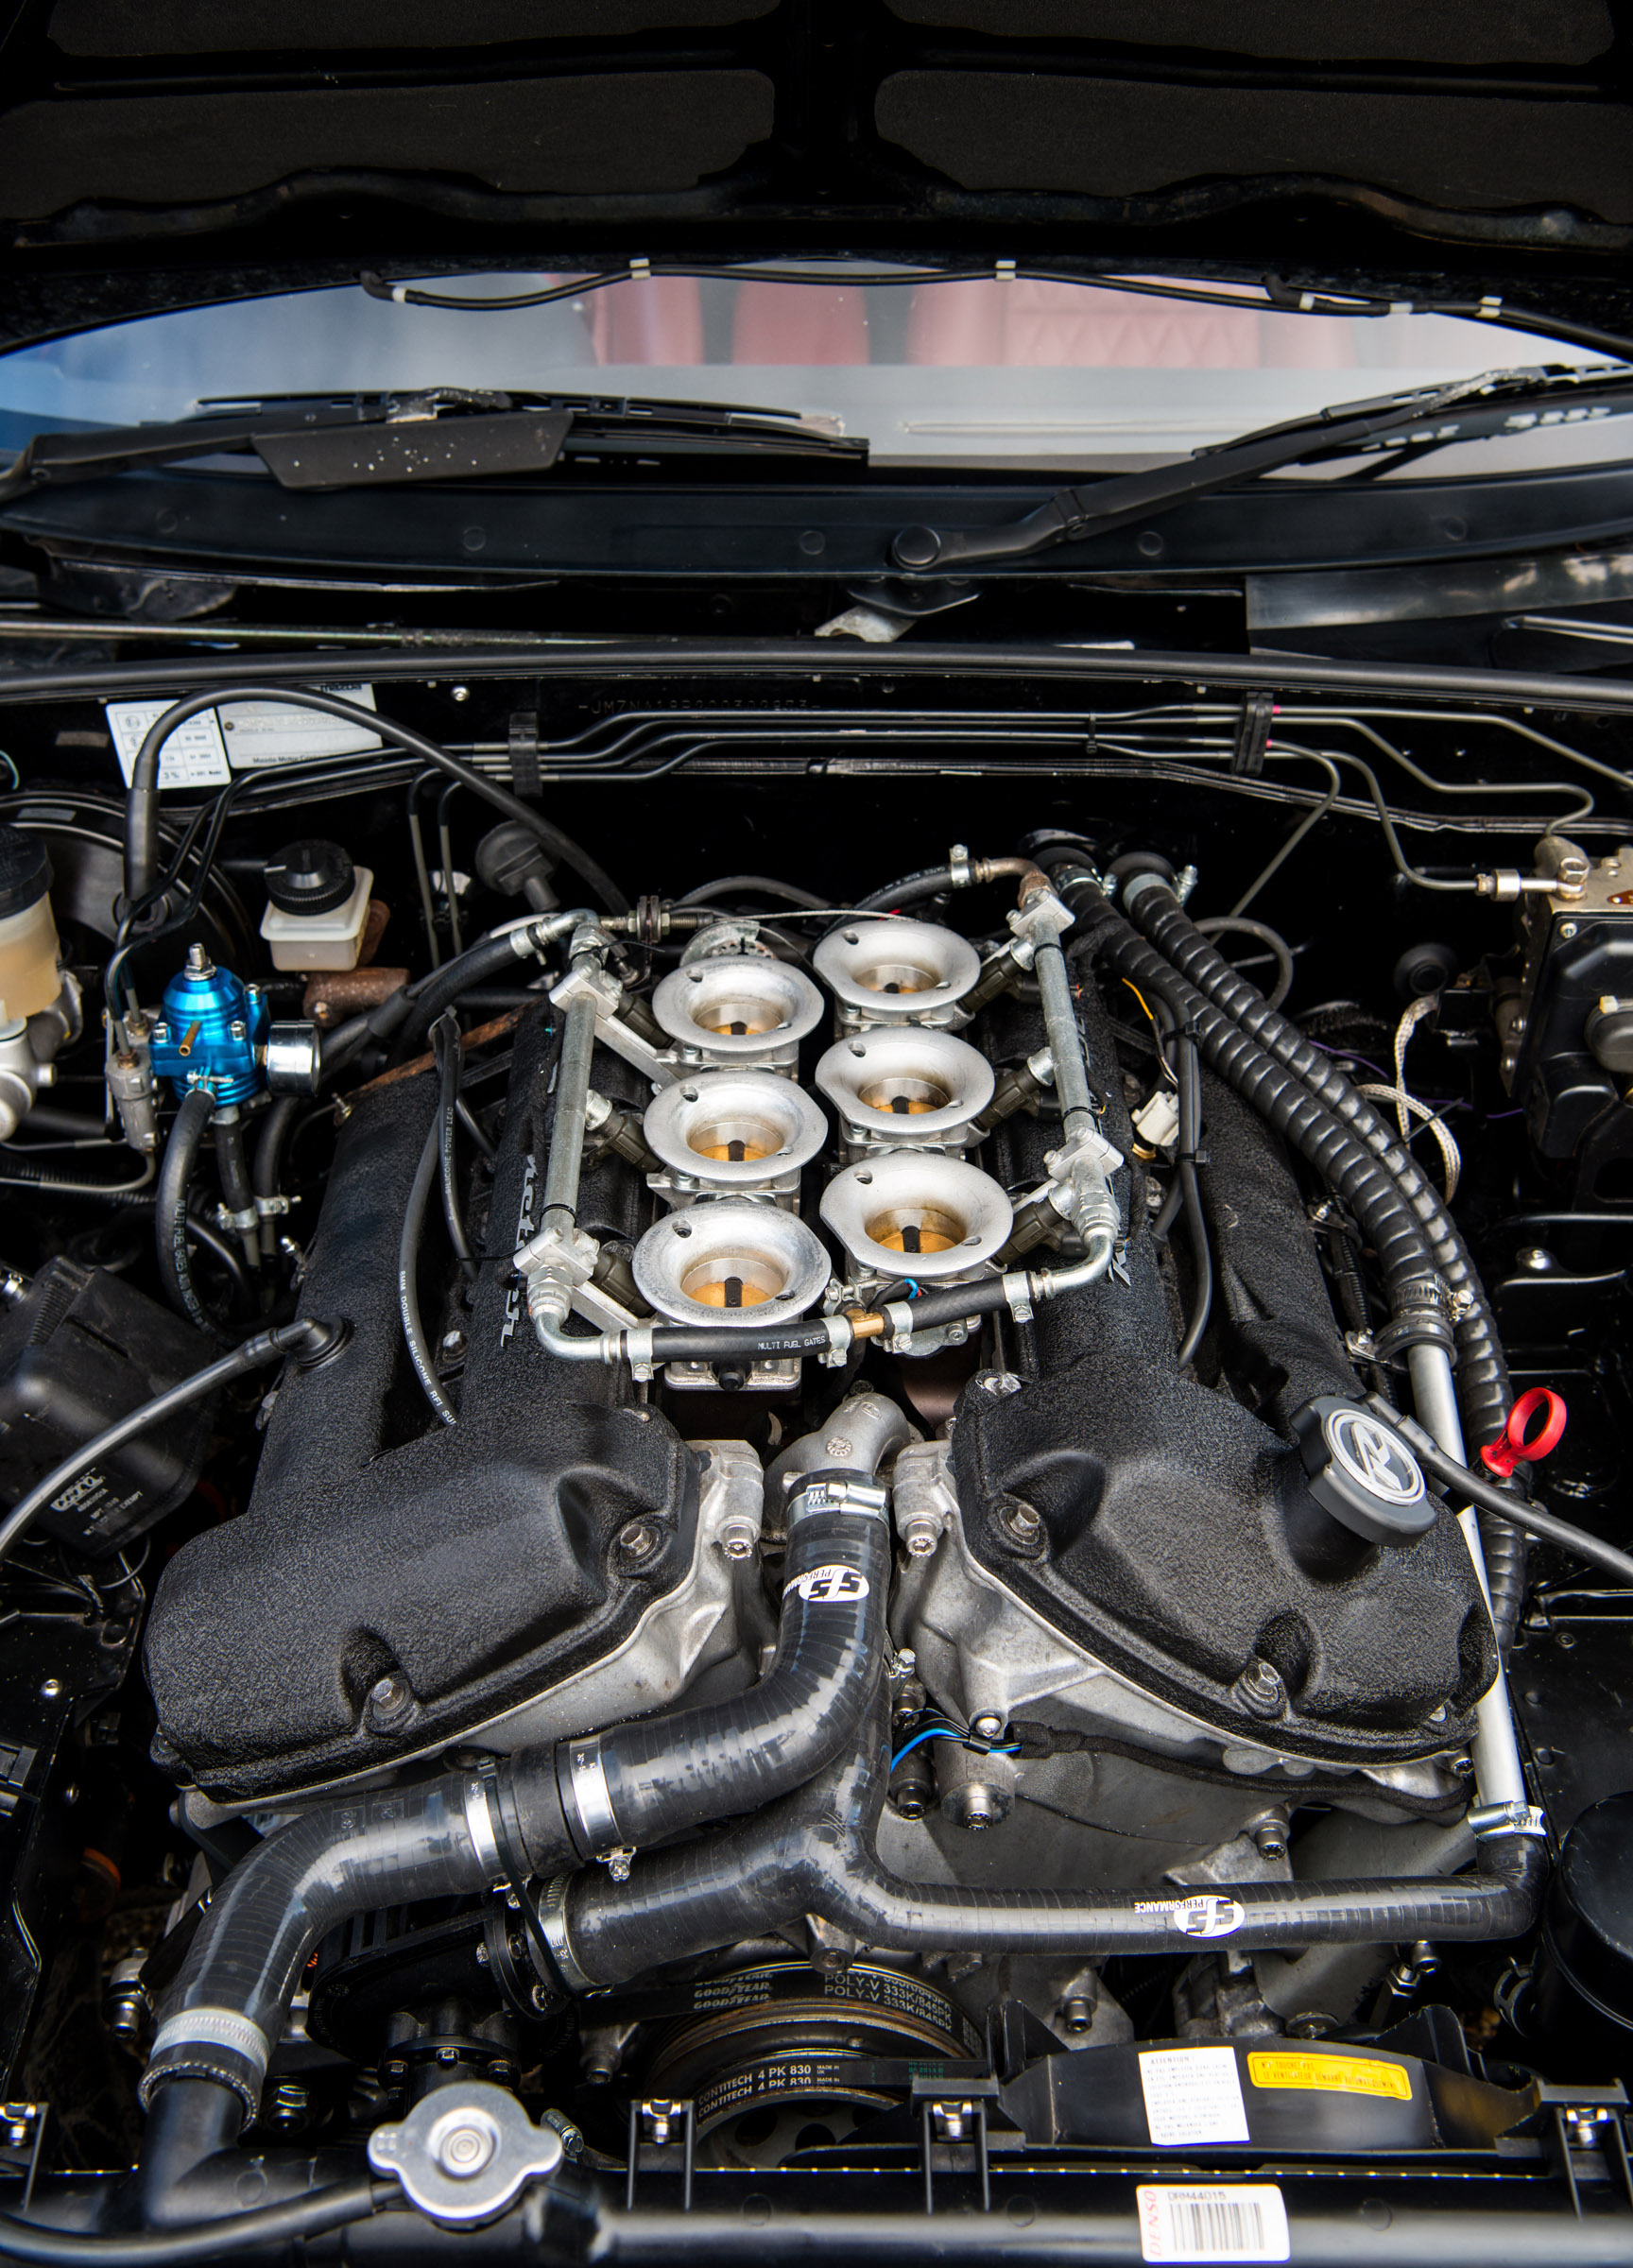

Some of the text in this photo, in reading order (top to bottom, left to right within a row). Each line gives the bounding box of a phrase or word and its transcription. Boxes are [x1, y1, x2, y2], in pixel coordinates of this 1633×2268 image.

[400, 1296, 413, 1335] DOUBLE
[408, 1340, 432, 1386] SILICONE
[429, 1390, 443, 1407] RFI
[757, 1335, 826, 1350] MULTI FUEL GATES
[1134, 1899, 1204, 1915] PERFORMANCE
[694, 1982, 772, 1999] GOODYEAR
[824, 1972, 880, 1991] POLY-V
[824, 1984, 880, 2002] POLY-V
[698, 2072, 753, 2106] CONTITECH
[757, 2070, 765, 2080] 4
[768, 2066, 786, 2078] PK
[790, 2064, 812, 2075] 830
[698, 2085, 753, 2119] CONTITECH
[757, 2082, 765, 2092] 4
[768, 2078, 786, 2089] PK
[1143, 2190, 1162, 2257] DENSO
